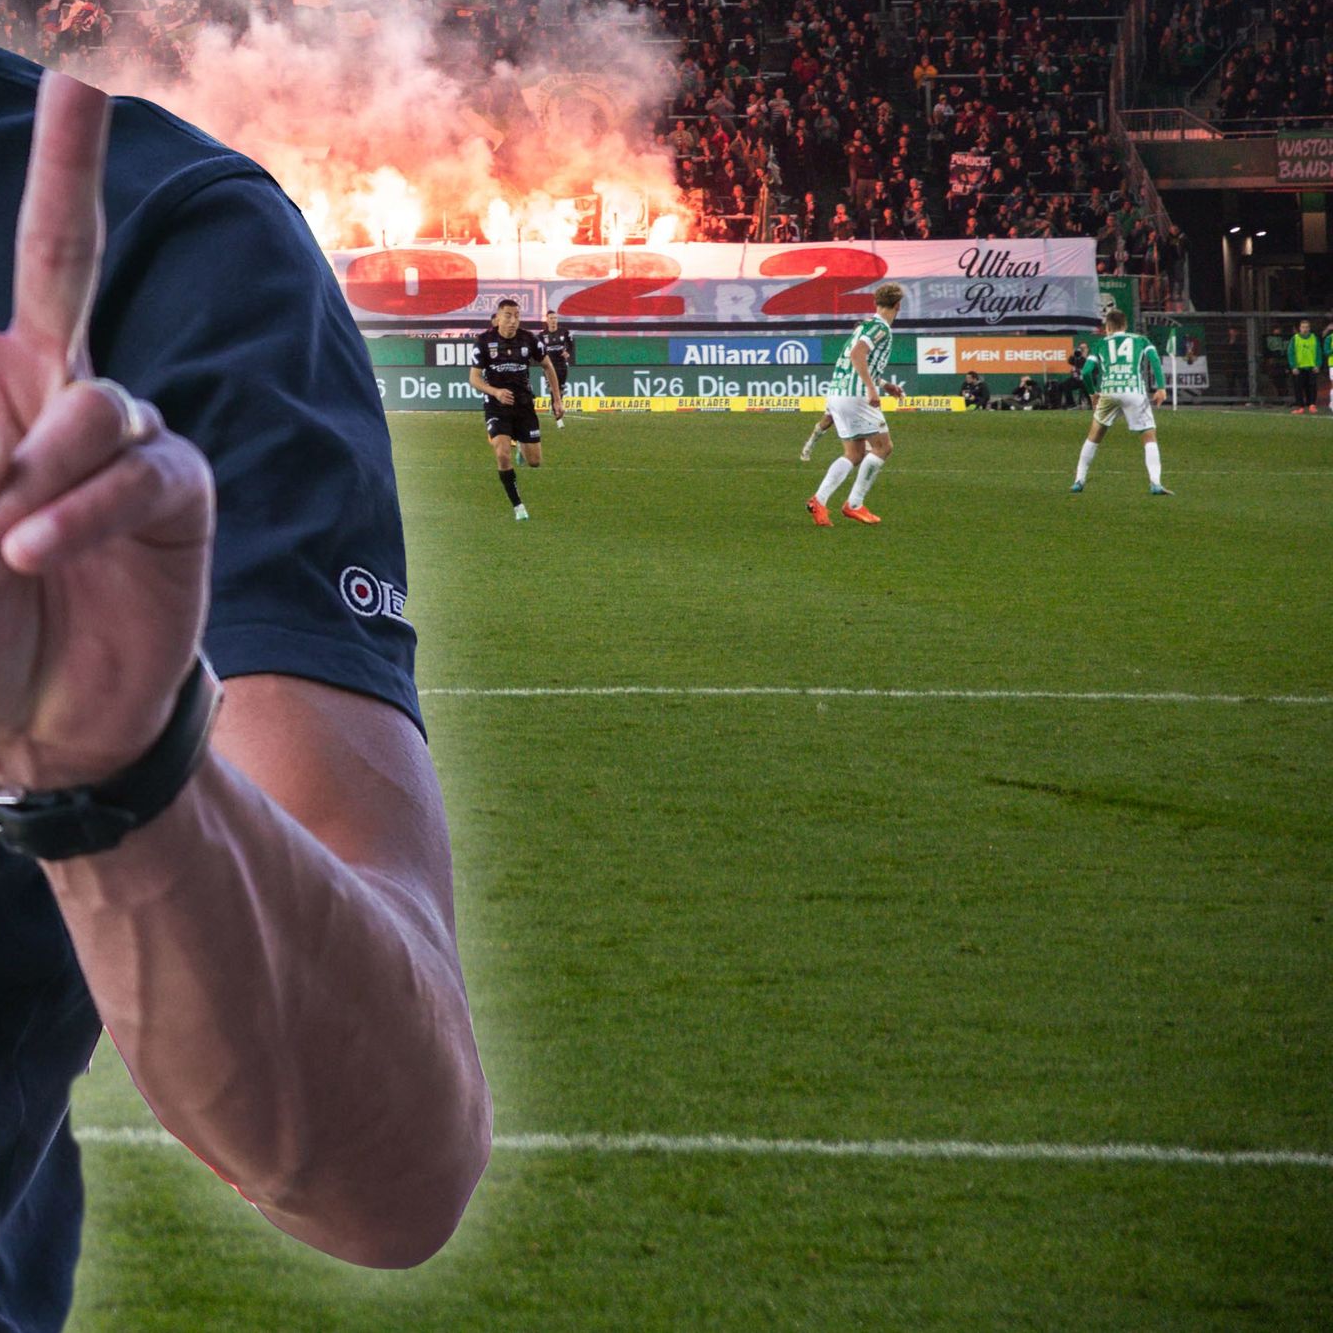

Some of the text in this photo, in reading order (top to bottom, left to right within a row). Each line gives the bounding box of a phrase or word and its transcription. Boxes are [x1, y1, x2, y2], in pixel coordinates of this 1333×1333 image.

[1277, 159, 1333, 178] BAND
[958, 248, 1042, 279] Ultras
[957, 282, 1049, 324] Rapid
[683, 344, 771, 365] Allianz
[961, 350, 1067, 361] WIEN ENERGIE
[1107, 337, 1134, 363] 14
[400, 376, 442, 399] Die
[634, 374, 684, 397] N26
[698, 375, 741, 397] Die
[746, 374, 830, 397] mobile
